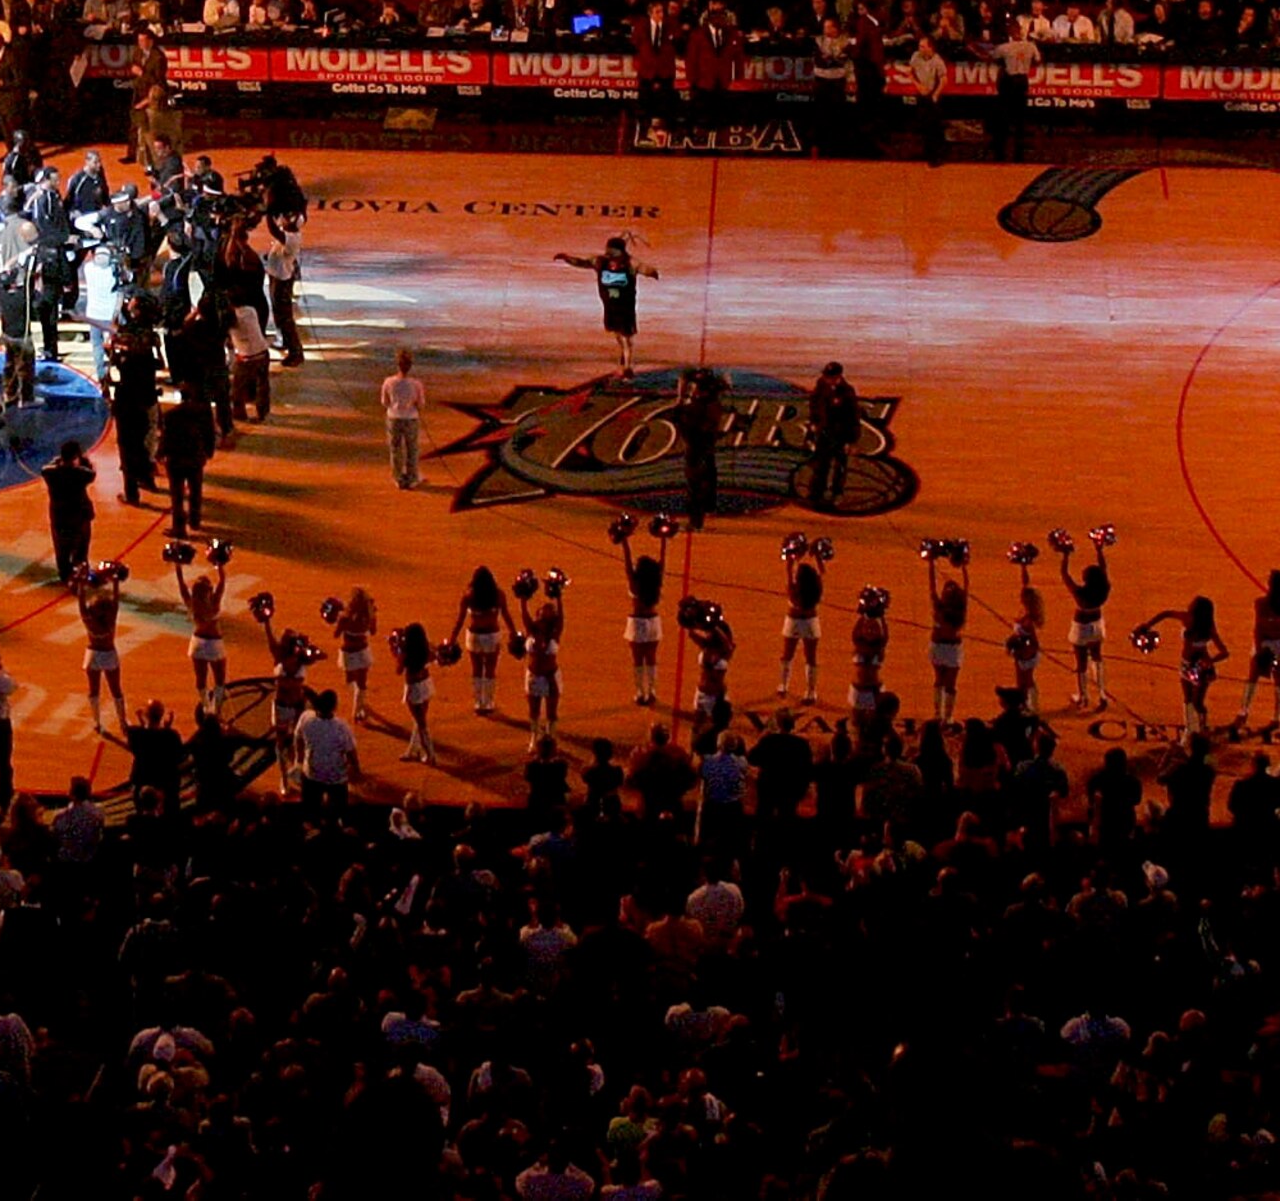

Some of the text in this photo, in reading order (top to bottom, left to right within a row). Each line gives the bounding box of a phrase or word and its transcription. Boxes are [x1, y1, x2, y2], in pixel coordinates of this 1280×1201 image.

[286, 47, 473, 75] MODELL'S
[508, 52, 639, 79] MODEL
[319, 72, 444, 83] SPORTING GOODS
[317, 199, 662, 219] OVIA CENTER
